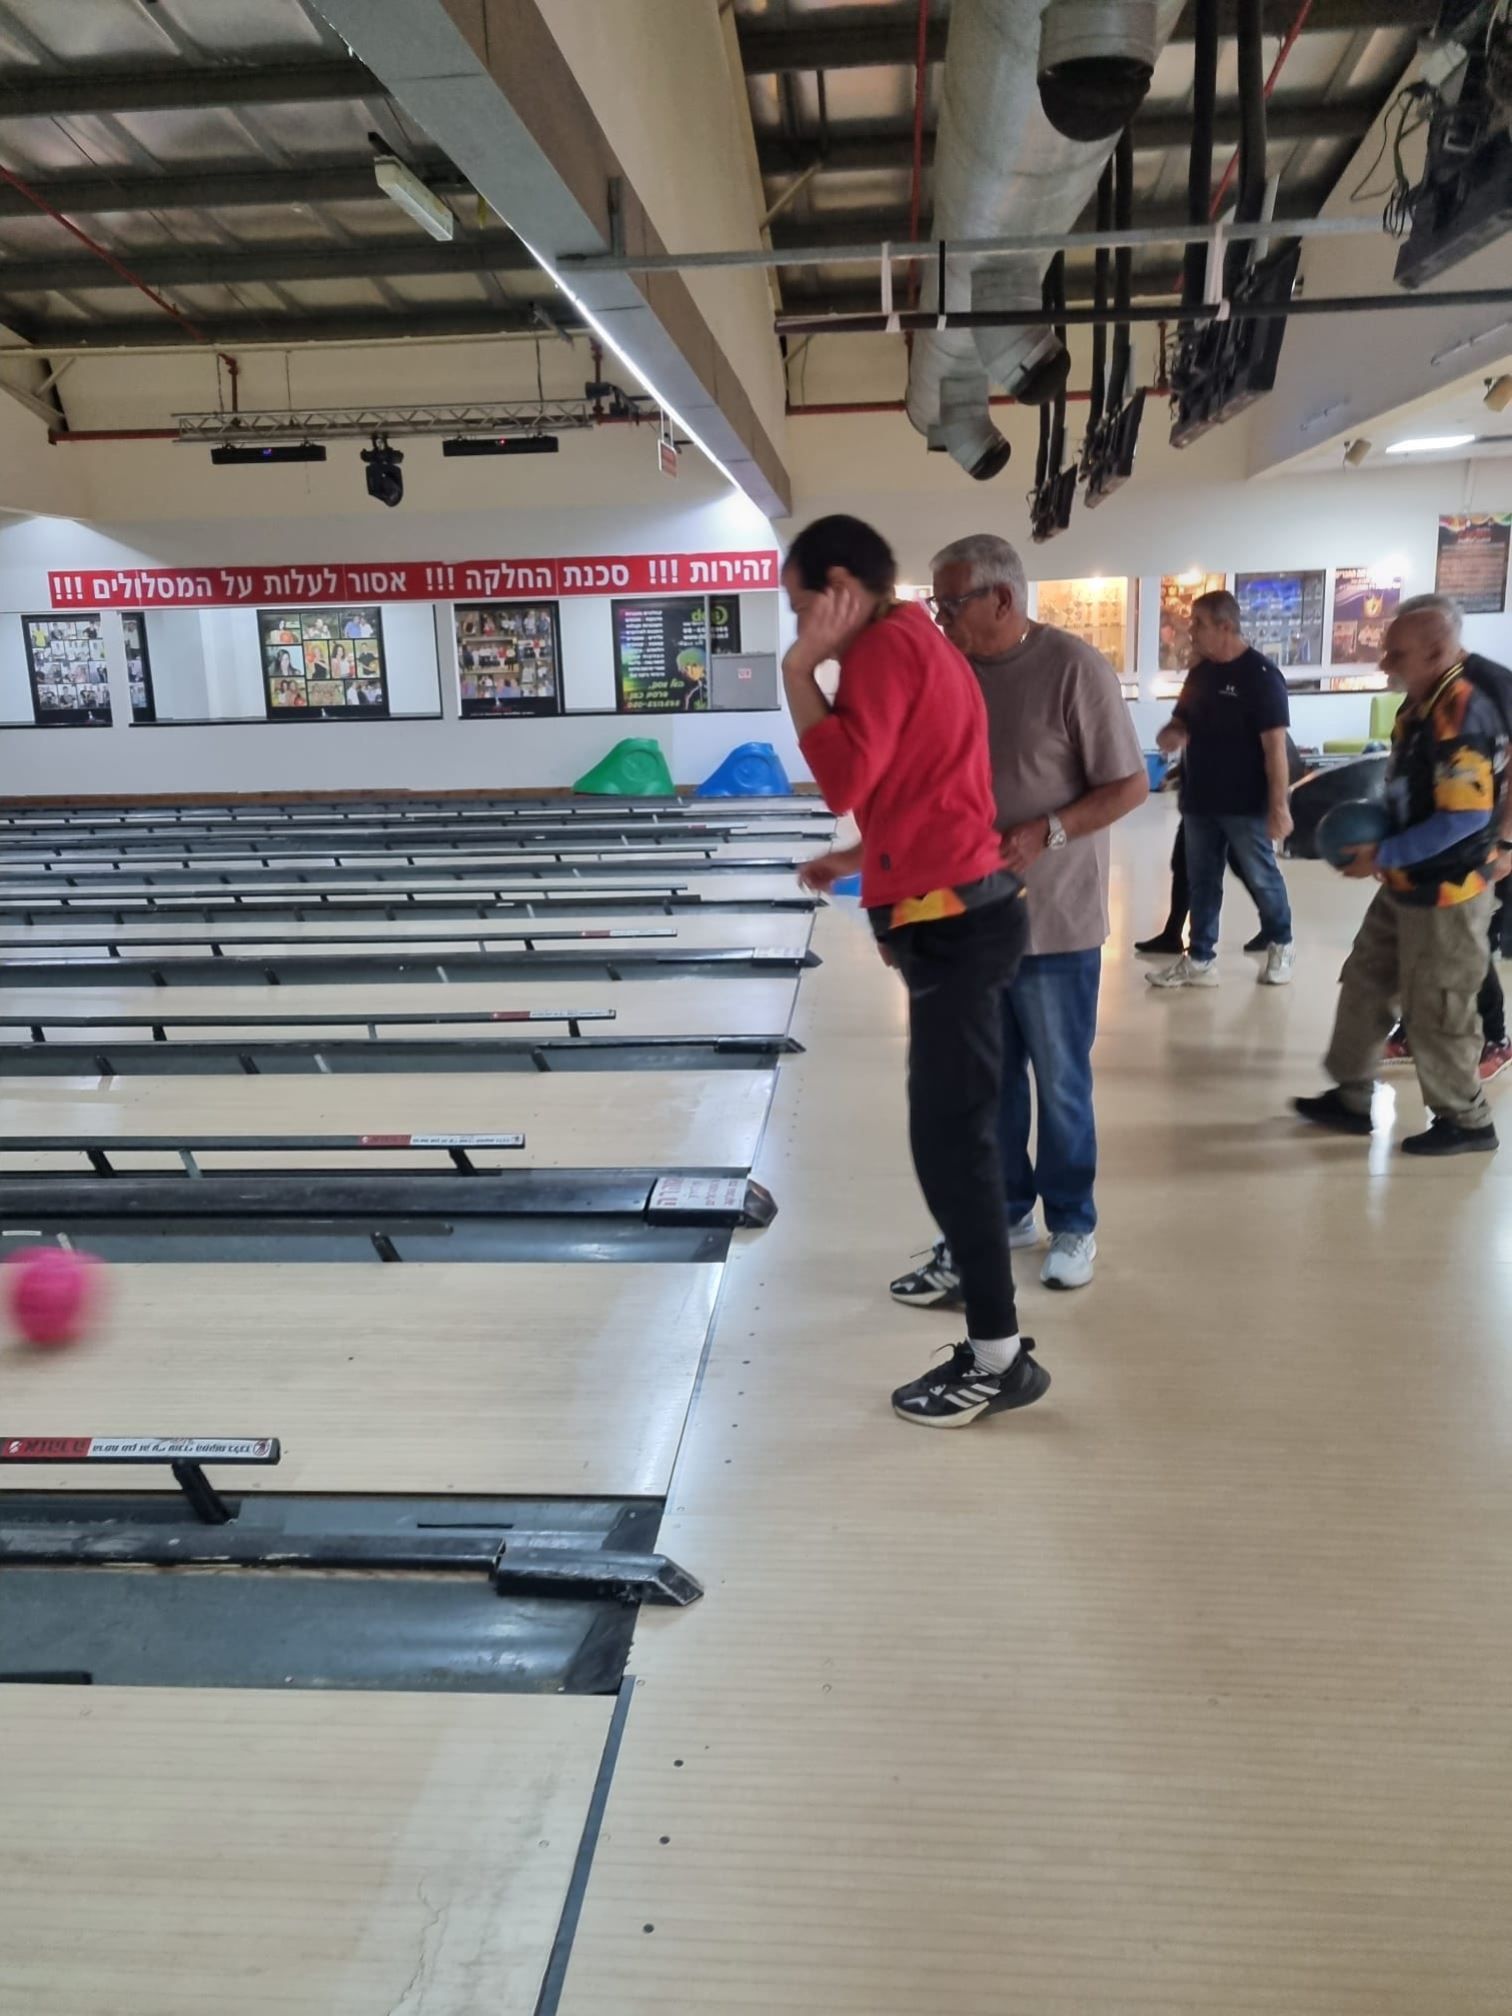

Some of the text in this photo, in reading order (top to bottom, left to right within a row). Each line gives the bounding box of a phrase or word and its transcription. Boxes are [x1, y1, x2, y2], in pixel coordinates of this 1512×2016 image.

[220, 570, 253, 599] על
[263, 568, 338, 597] לעלות
[347, 571, 407, 593] אסור
[466, 562, 552, 595] החלקה
[563, 564, 630, 588] סכנת
[689, 558, 773, 584] זהירות
[92, 572, 212, 600] המסלולים
